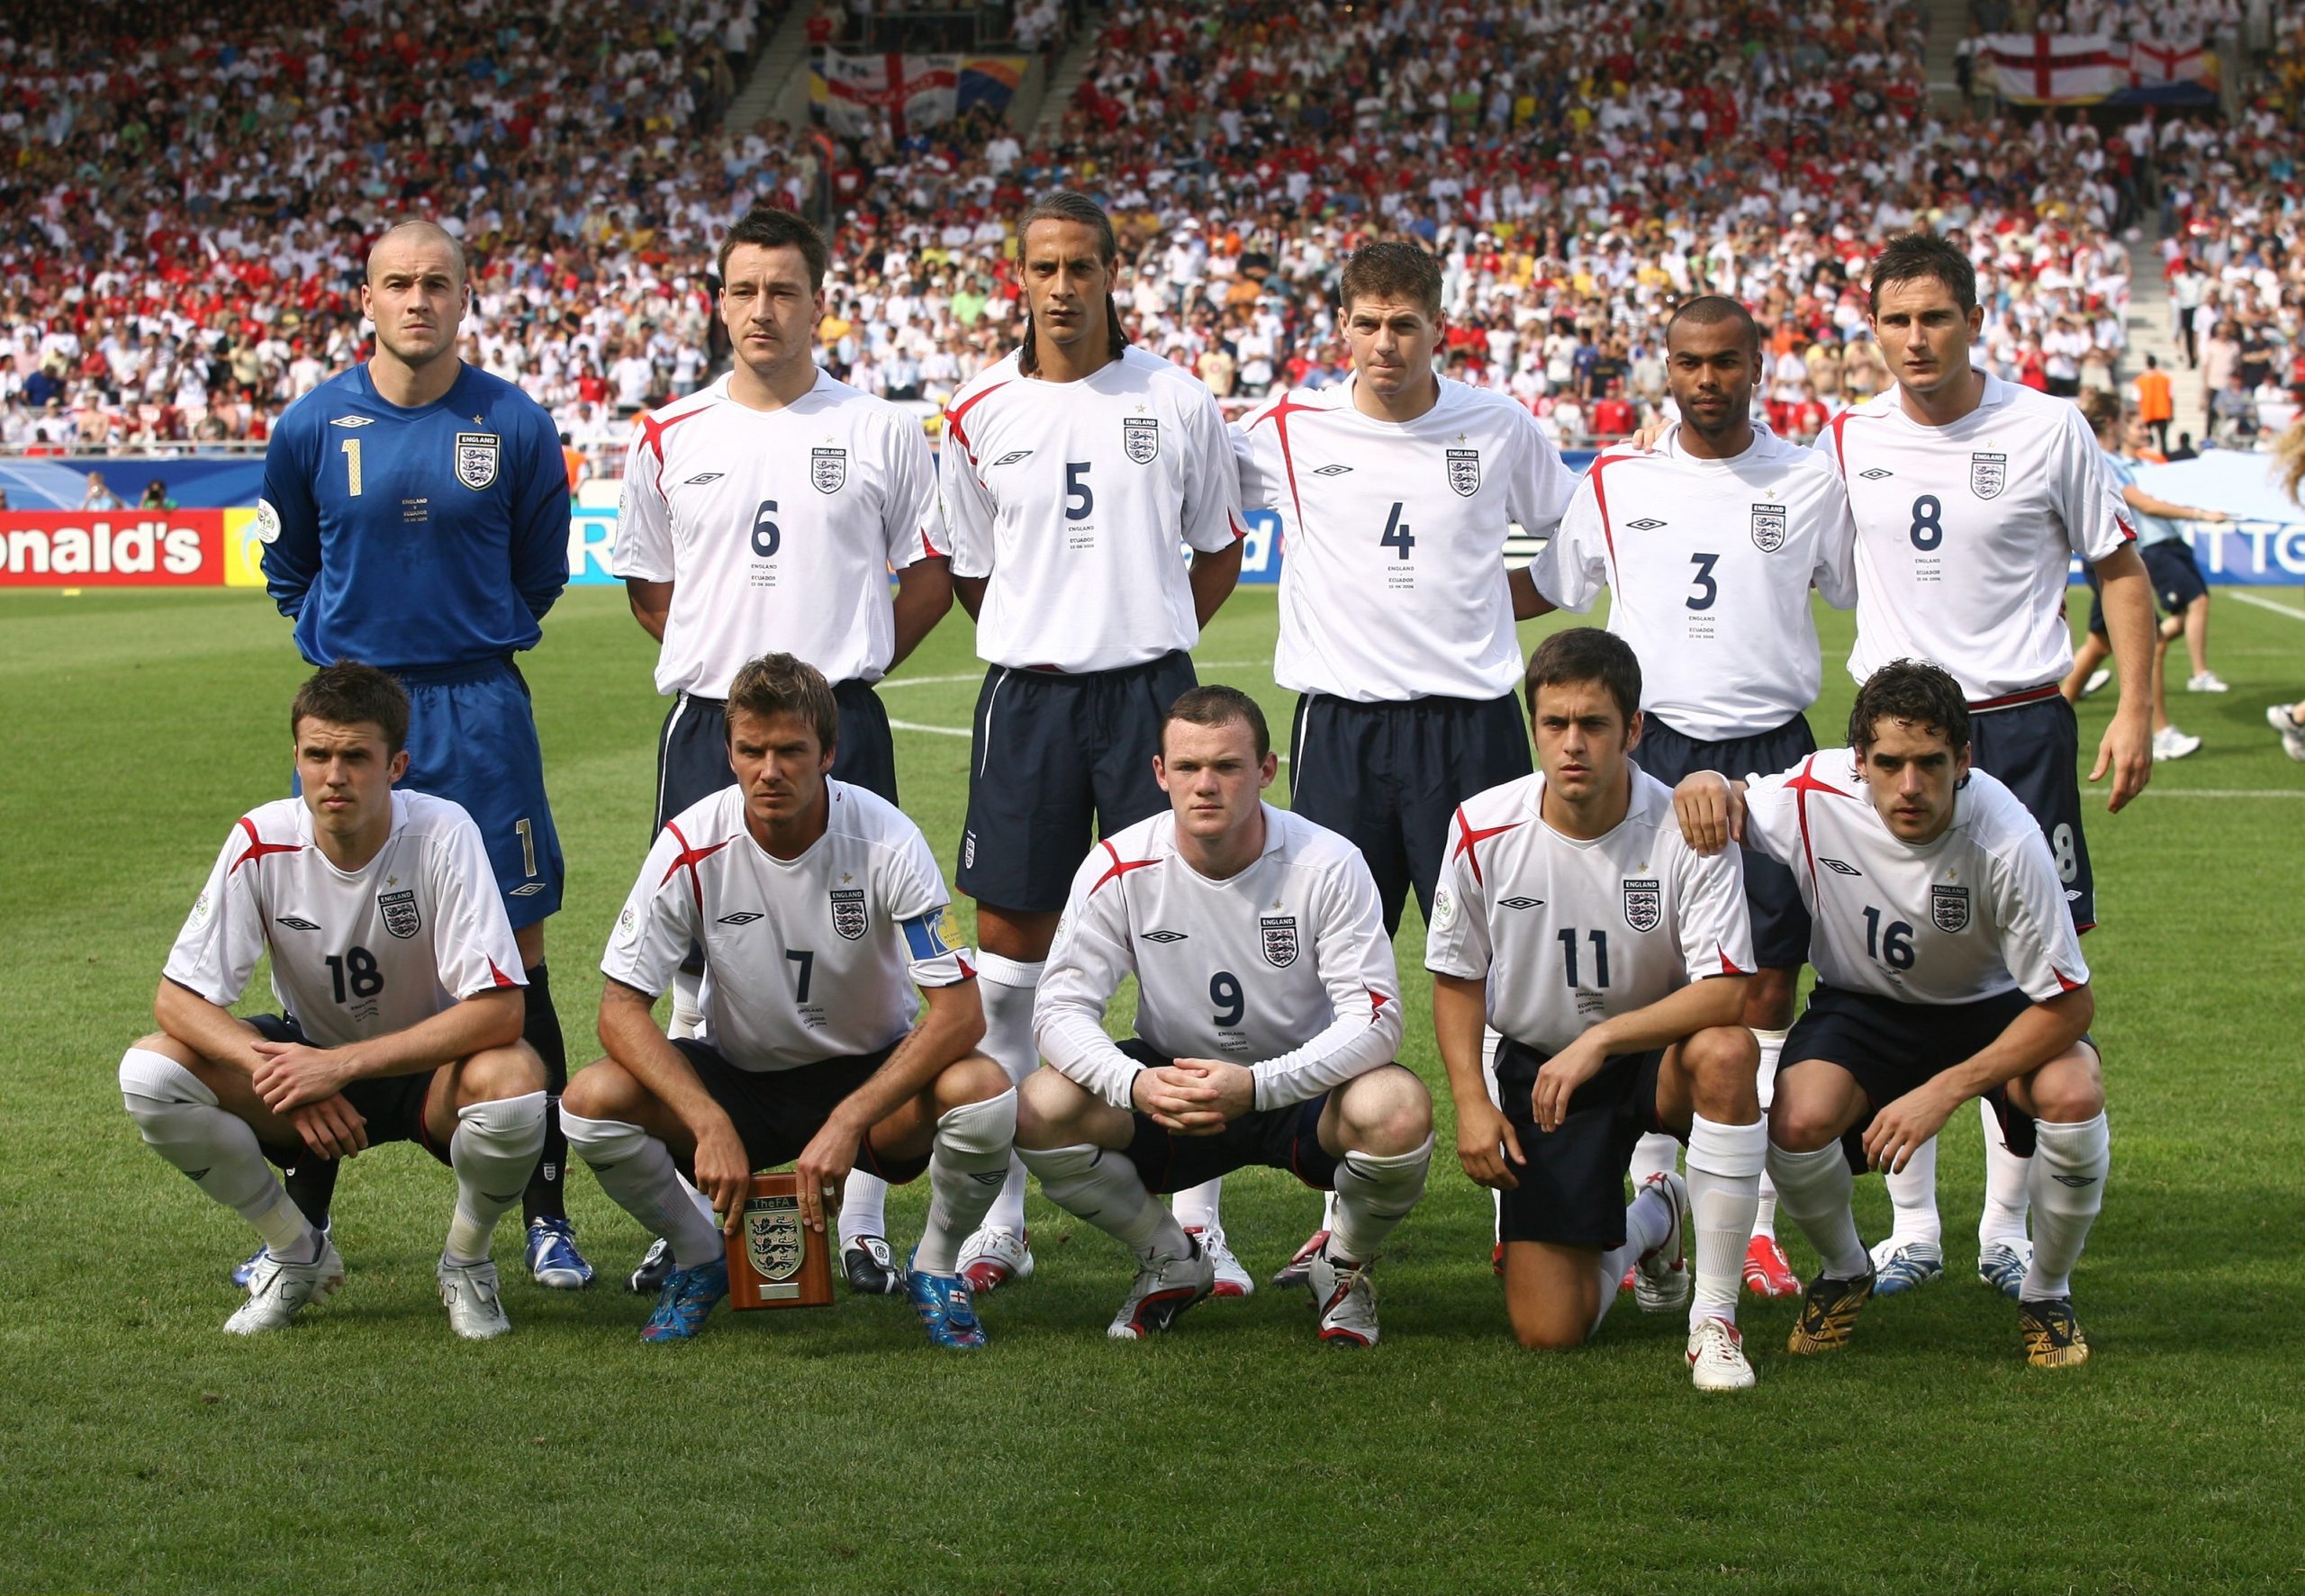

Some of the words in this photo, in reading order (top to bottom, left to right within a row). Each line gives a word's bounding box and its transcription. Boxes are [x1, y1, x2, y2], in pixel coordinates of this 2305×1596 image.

[461, 436, 496, 444] ENGLAND
[1125, 419, 1157, 427] ENGLAND
[340, 438, 363, 497] 1
[814, 448, 845, 456] ENGLAND
[1447, 450, 1478, 458] ENGLAND
[1974, 453, 2005, 461] ENGLAND
[1065, 461, 1094, 520] 5
[1753, 505, 1785, 513] ENGLAND
[0, 521, 203, 574] nald's
[751, 500, 781, 558] 6
[1379, 501, 1415, 560] 4
[1910, 494, 1943, 552] 8
[1685, 552, 1721, 611] 3
[515, 817, 538, 878] 1
[2053, 822, 2078, 884] 8
[380, 891, 411, 904] ENGLAND
[832, 891, 863, 899] ENGLAND
[1624, 880, 1658, 889] ENGLAND
[1933, 886, 1967, 895] ENGLAND
[1262, 917, 1294, 926] ENGLAND
[1862, 905, 1915, 970] 16
[325, 945, 384, 1004] 18
[785, 949, 815, 1003] 7
[1557, 927, 1611, 988] 11
[1209, 970, 1245, 1028] 9
